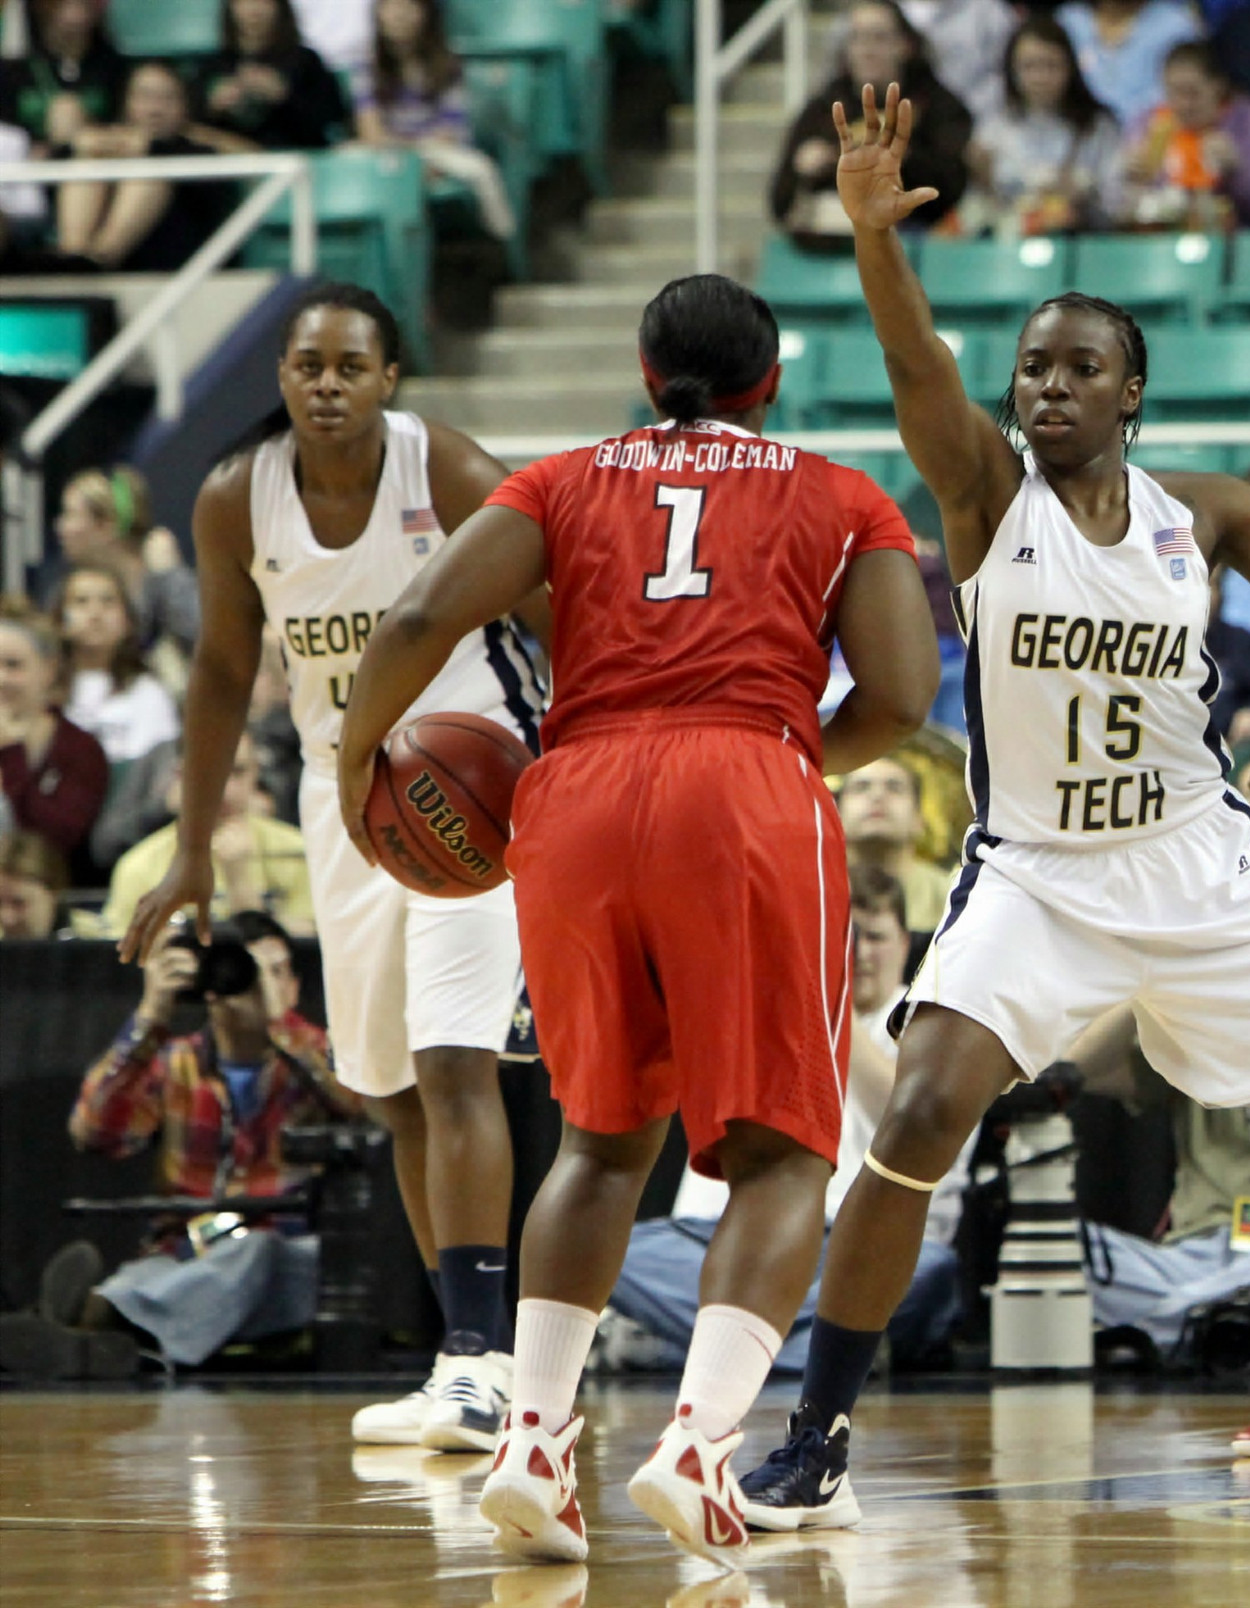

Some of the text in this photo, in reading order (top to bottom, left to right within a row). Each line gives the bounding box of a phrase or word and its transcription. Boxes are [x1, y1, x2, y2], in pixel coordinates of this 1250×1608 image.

[594, 440, 797, 473] GOODWIN-COLEMAN
[643, 482, 713, 602] 1
[285, 610, 389, 658] GEOR
[1011, 612, 1189, 679] GEORGIA
[1065, 694, 1142, 763] 15
[406, 770, 494, 877] Wilson
[1055, 770, 1166, 832] TECH
